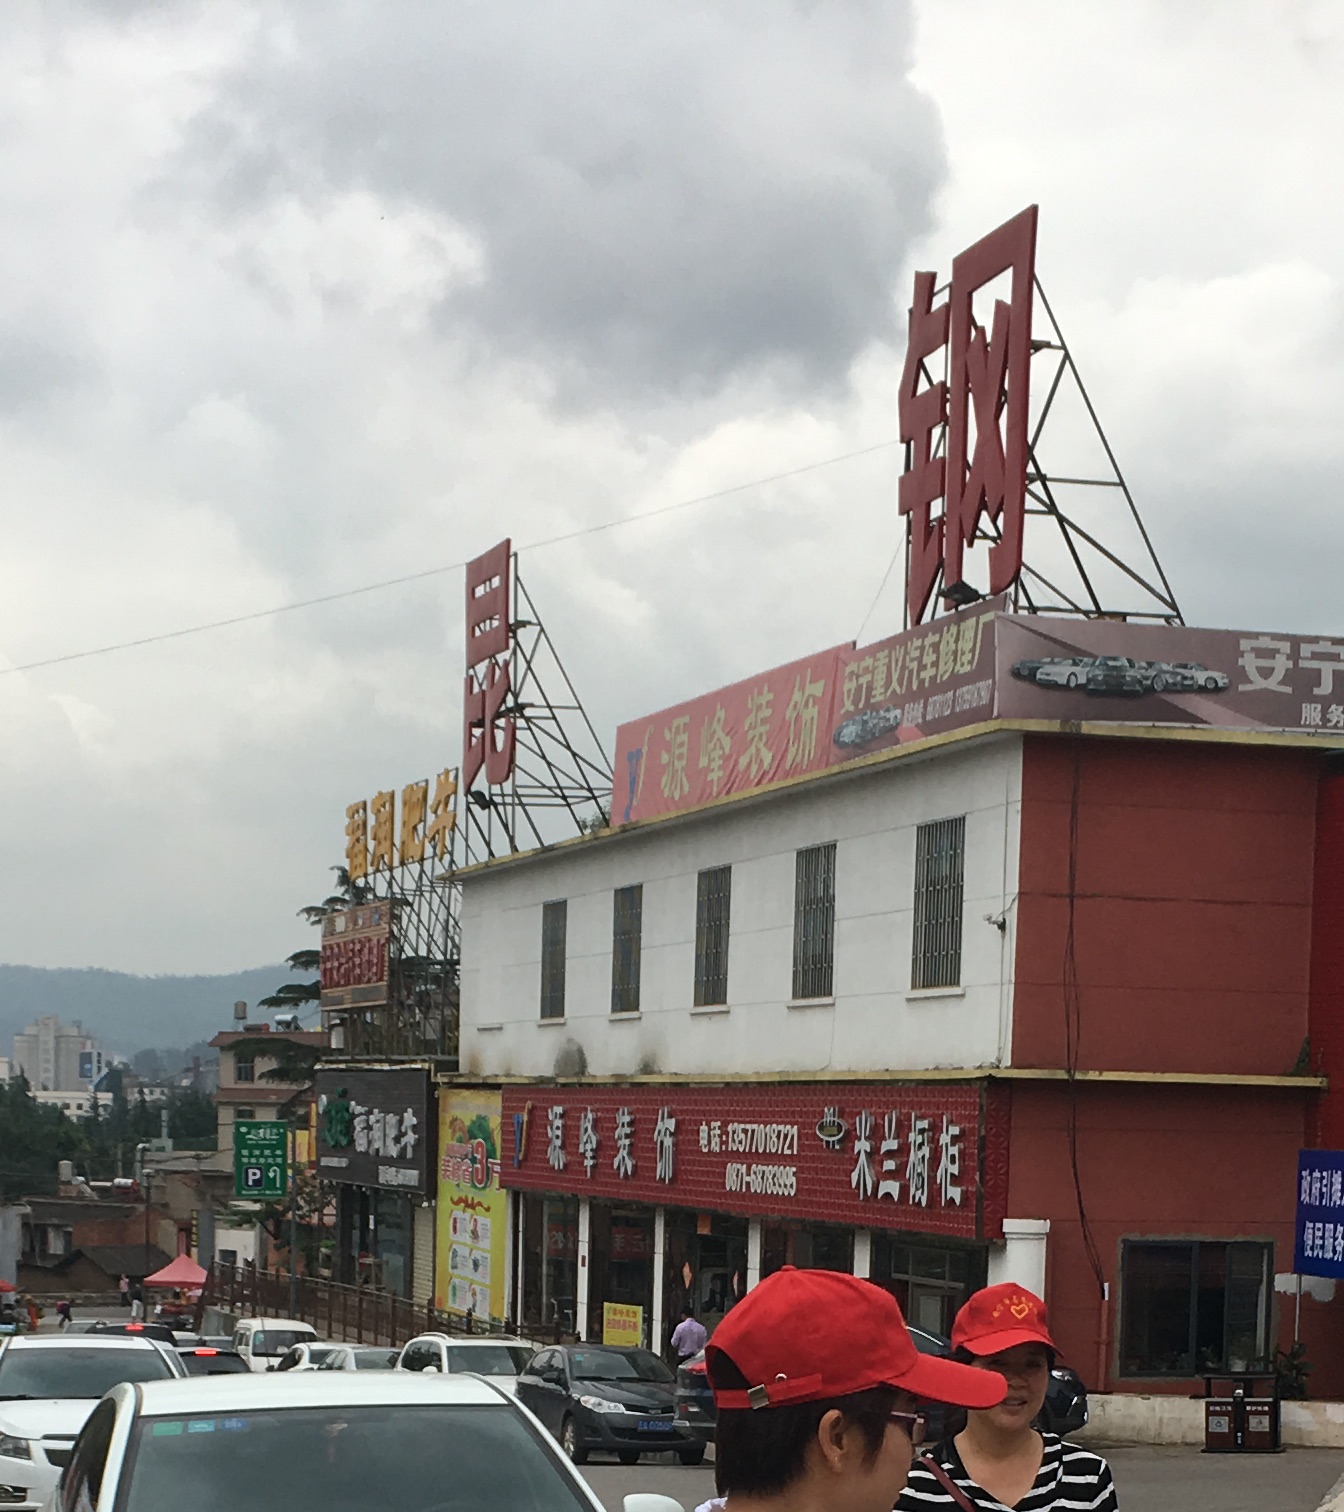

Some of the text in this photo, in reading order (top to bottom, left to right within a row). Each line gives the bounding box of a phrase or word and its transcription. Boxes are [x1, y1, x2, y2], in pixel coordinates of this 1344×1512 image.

[899, 204, 1039, 628] 钢
[840, 611, 996, 714] 安宁重义汽车修理厂
[660, 668, 826, 801] 源峰装饰
[247, 1168, 261, 1186] P
[547, 1106, 676, 1184] 源峰装饰
[725, 1162, 797, 1197] 0871-68783995
[851, 1110, 961, 1208] 米兰橱柜
